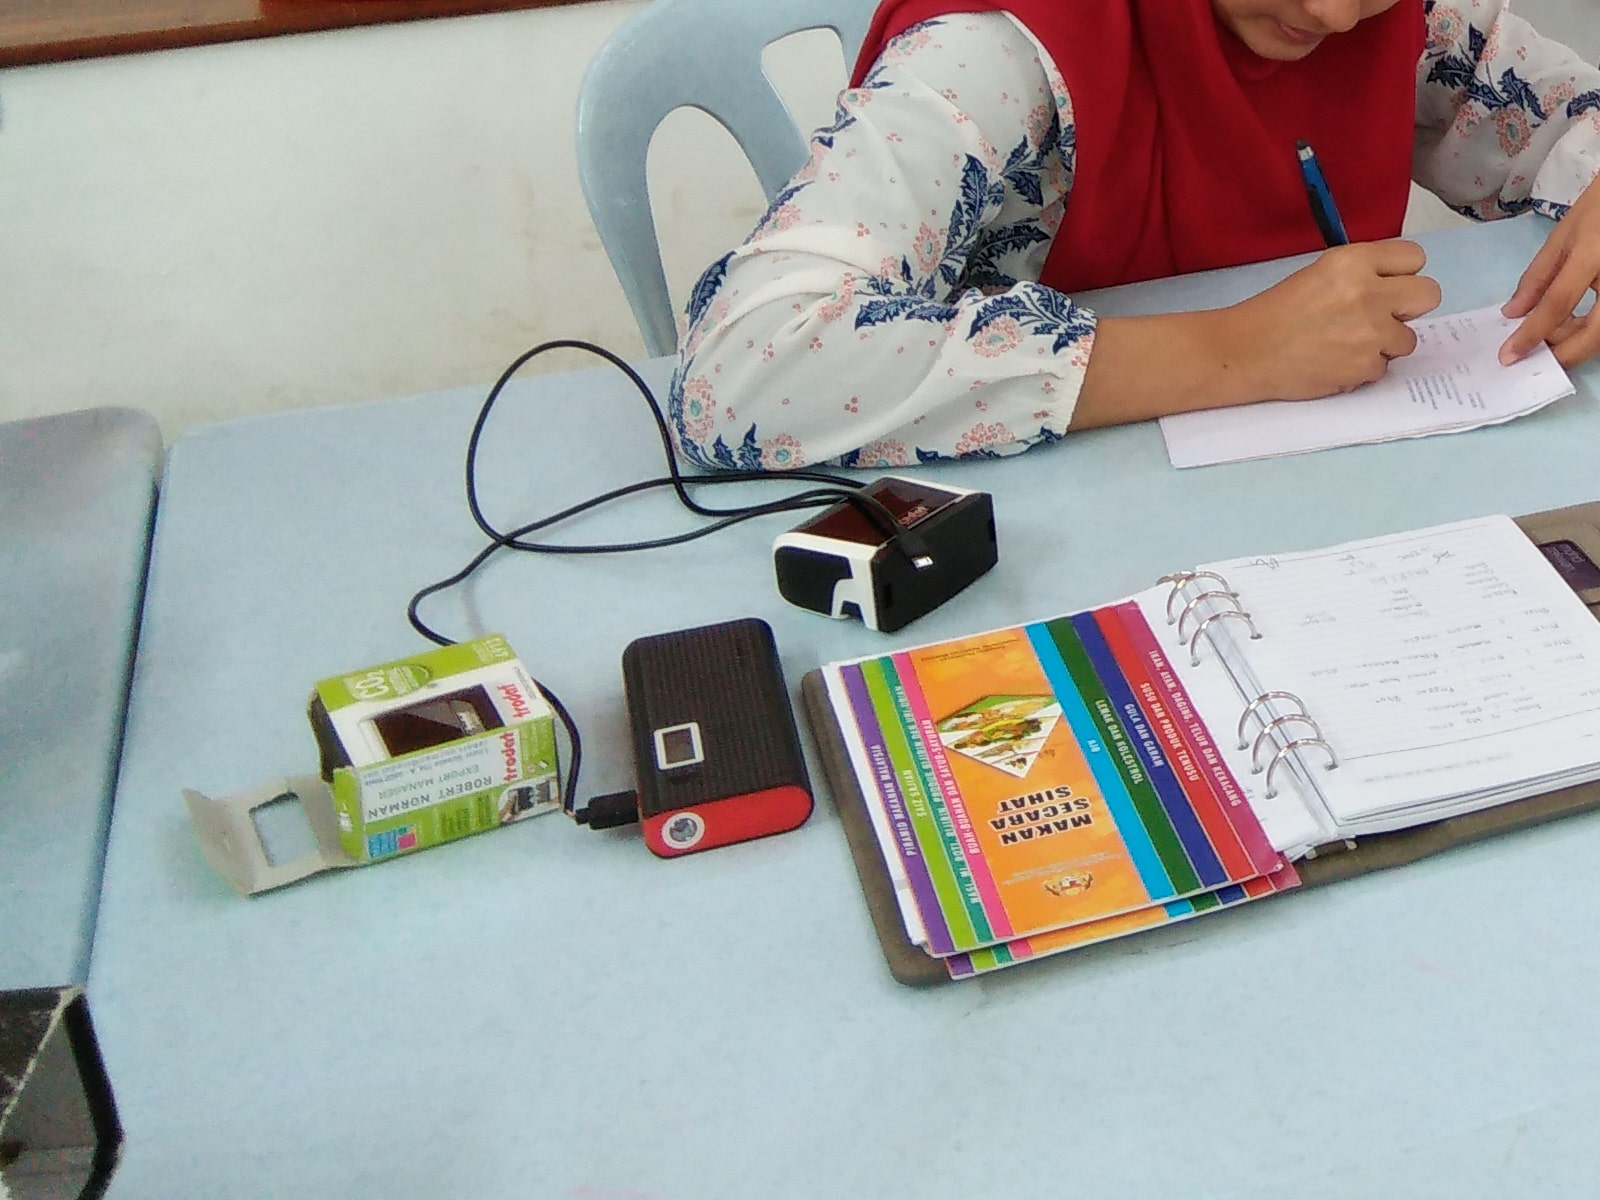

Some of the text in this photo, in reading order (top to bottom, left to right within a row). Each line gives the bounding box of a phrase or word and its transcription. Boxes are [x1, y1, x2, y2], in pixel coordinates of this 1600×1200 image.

[497, 683, 531, 718] trodat
[1086, 738, 1101, 752] AIR
[1095, 699, 1143, 784] LEMAK DAN KOLESTROL
[1124, 703, 1163, 766] GULA DAN GARAM
[1140, 682, 1199, 781] SUSU DAN PRODUK TENUSU
[438, 764, 479, 783] EXPORT
[499, 732, 518, 781] trodat
[1188, 722, 1208, 746] TELUR
[1202, 747, 1218, 764] DAN
[1211, 765, 1240, 806] KEKACANG
[368, 776, 492, 819] ROBERT NORMAN
[378, 778, 434, 800] MANAGER
[871, 744, 916, 856] PIRAMID MAKANAN MALAYSIA
[903, 769, 927, 816] SAIZ SAJIAN
[922, 719, 979, 854] BUAH-BUAHAN DAN SAYUR-SAYURAN
[1000, 786, 1071, 812] SIHAT
[990, 798, 1090, 830] SECARA
[1000, 813, 1093, 845] MAKAN
